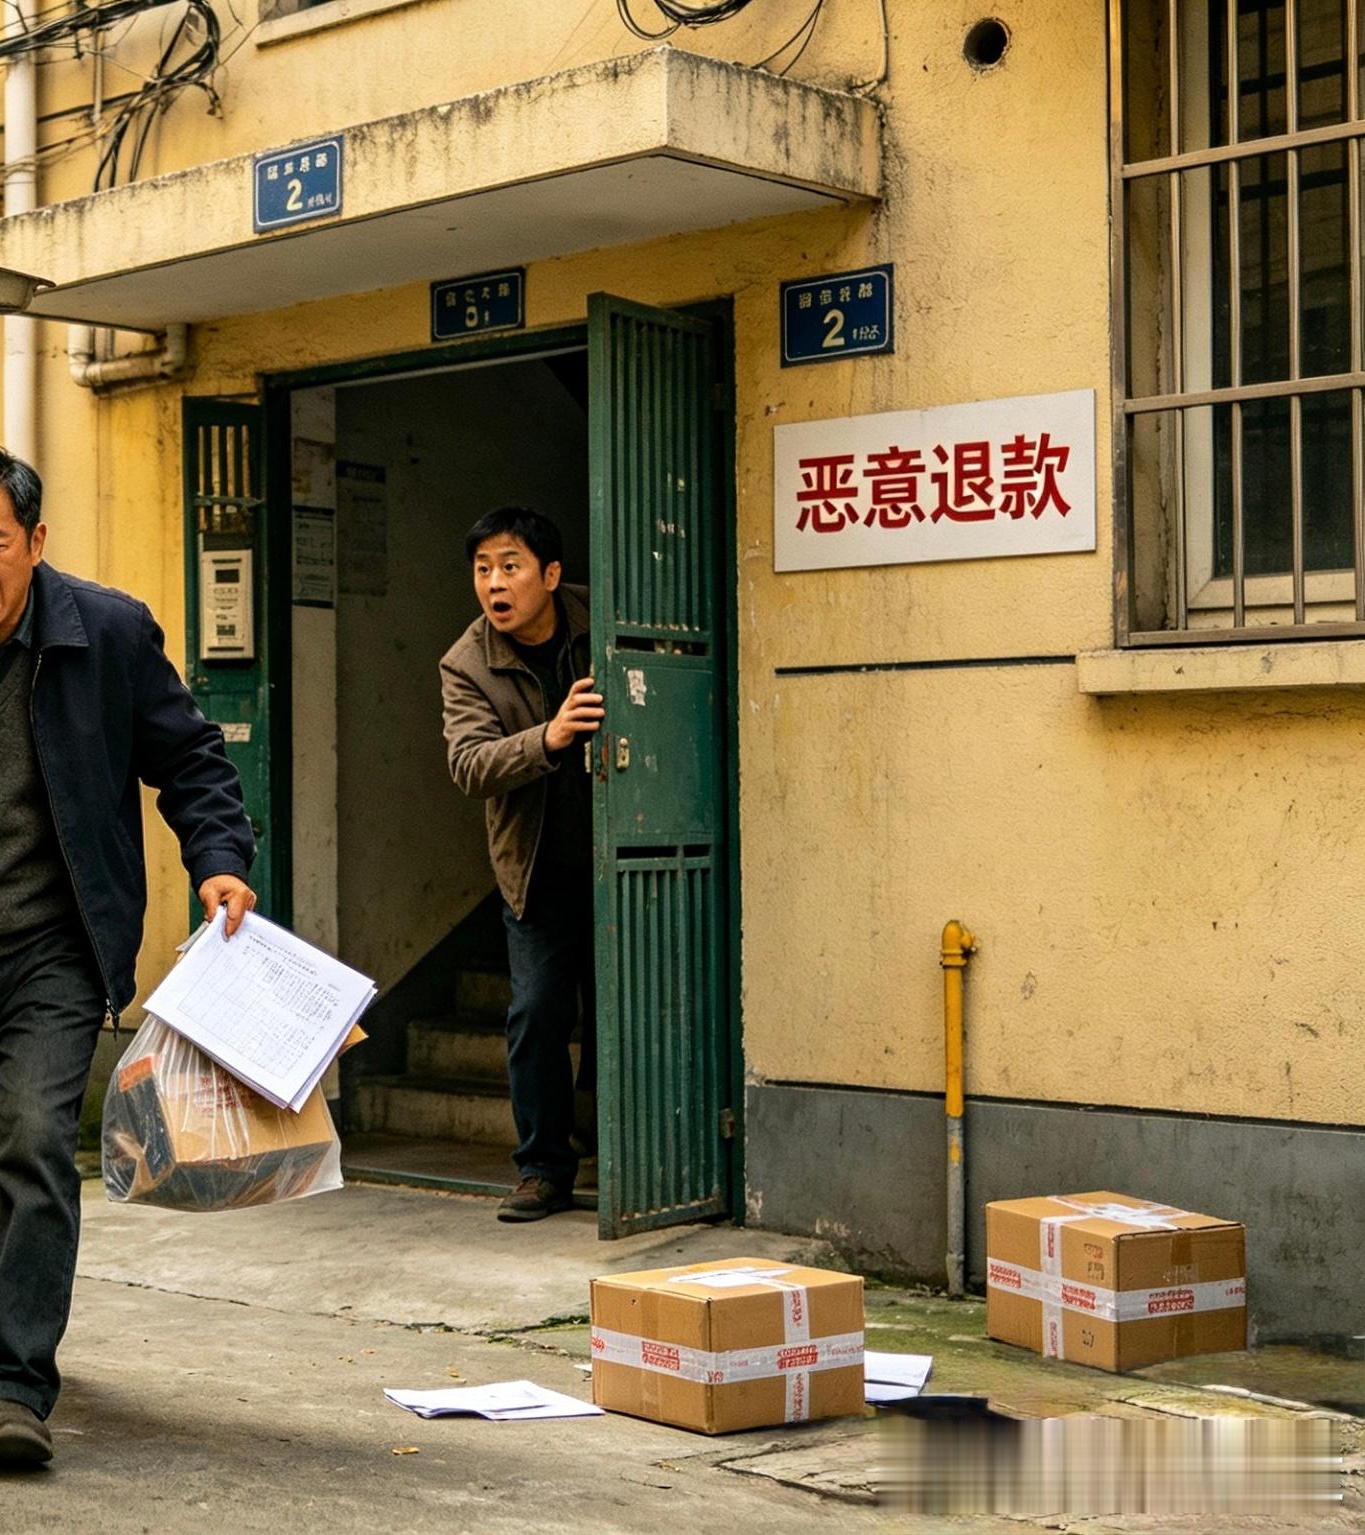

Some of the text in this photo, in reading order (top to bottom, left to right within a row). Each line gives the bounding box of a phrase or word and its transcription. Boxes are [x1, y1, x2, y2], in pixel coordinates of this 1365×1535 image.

[286, 178, 304, 212] 2
[821, 308, 845, 348] 2
[795, 432, 1072, 533] 恶意退款
